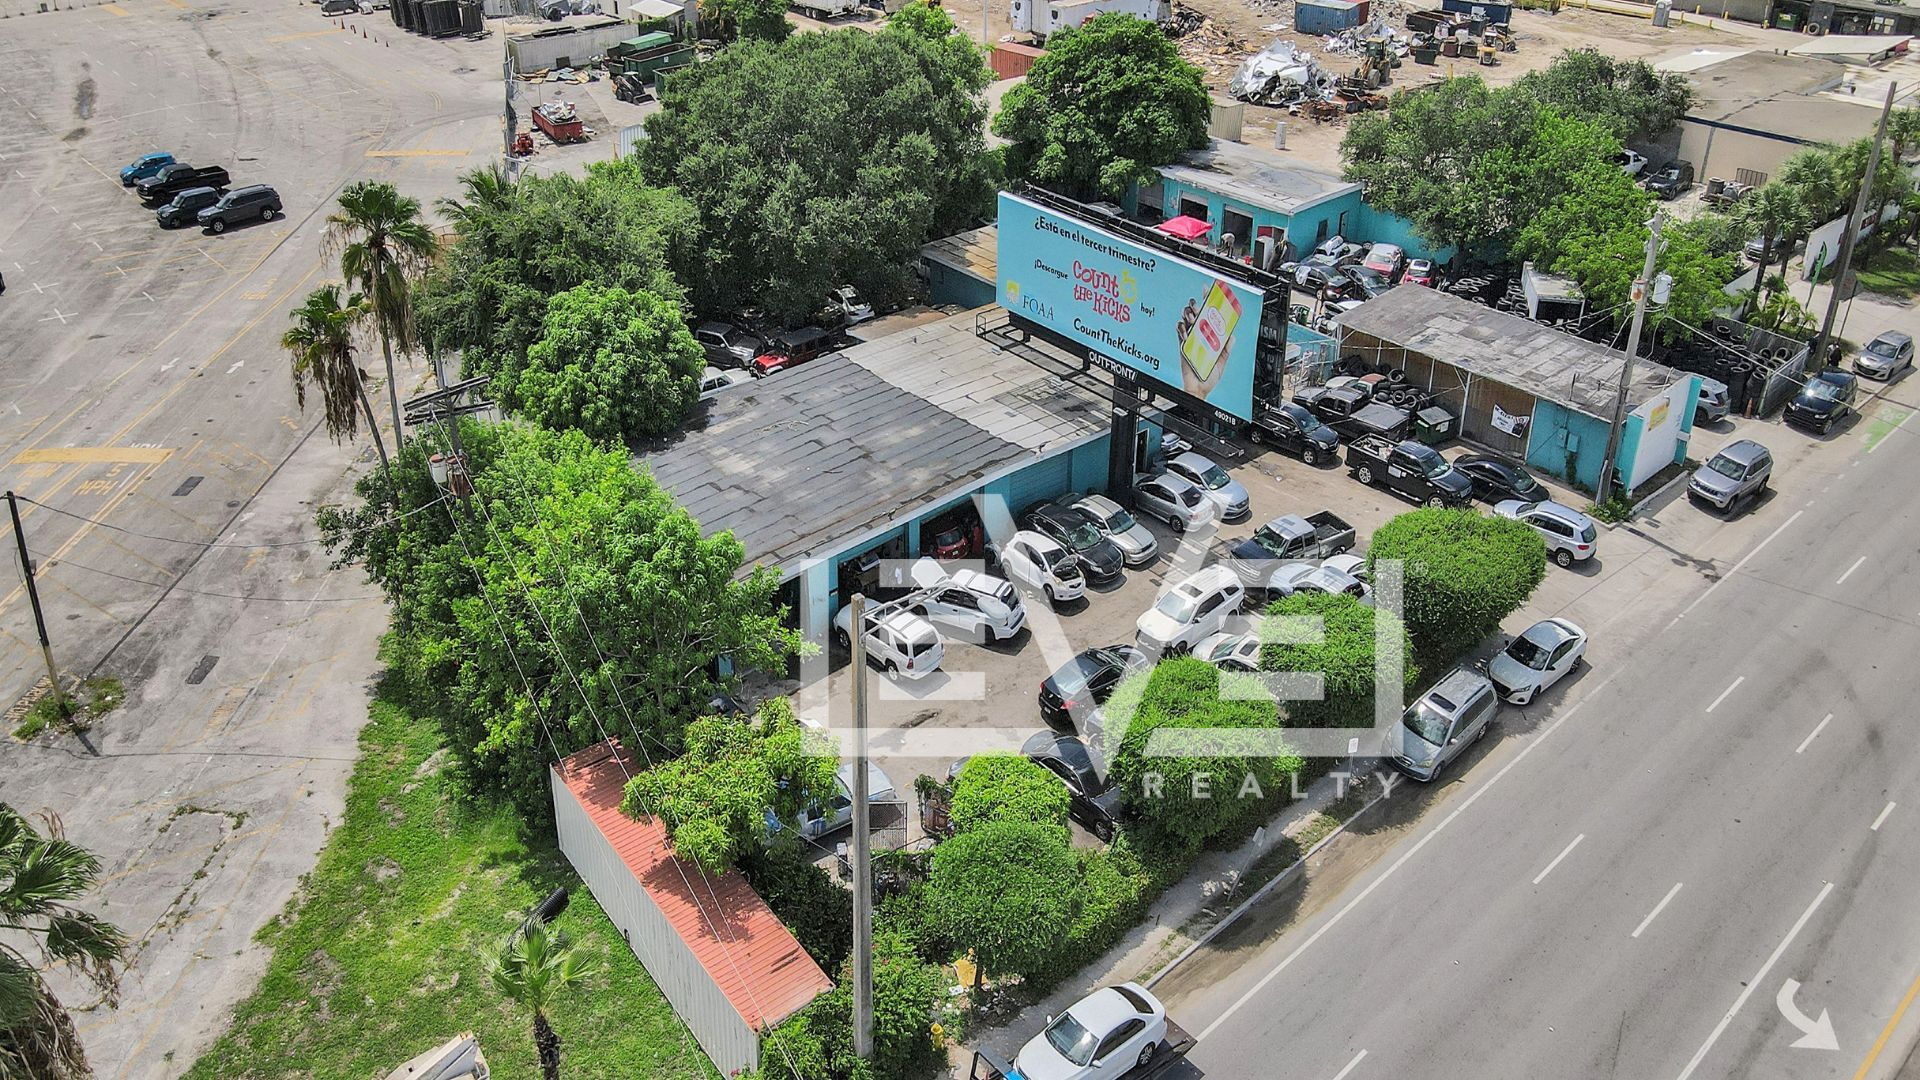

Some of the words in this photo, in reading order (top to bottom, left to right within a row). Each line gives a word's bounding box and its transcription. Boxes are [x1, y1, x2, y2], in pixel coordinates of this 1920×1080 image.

[1035, 215, 1058, 233] ¿Está
[1060, 228, 1070, 239] en
[1072, 230, 1080, 242] el
[1082, 234, 1107, 253] tercer
[1109, 246, 1156, 272] trimestre?
[1034, 259, 1068, 280] ¡Descargue
[1023, 295, 1054, 320] FOAA
[1140, 302, 1155, 318] hoy!
[1074, 318, 1160, 370] CountTheKicks.org
